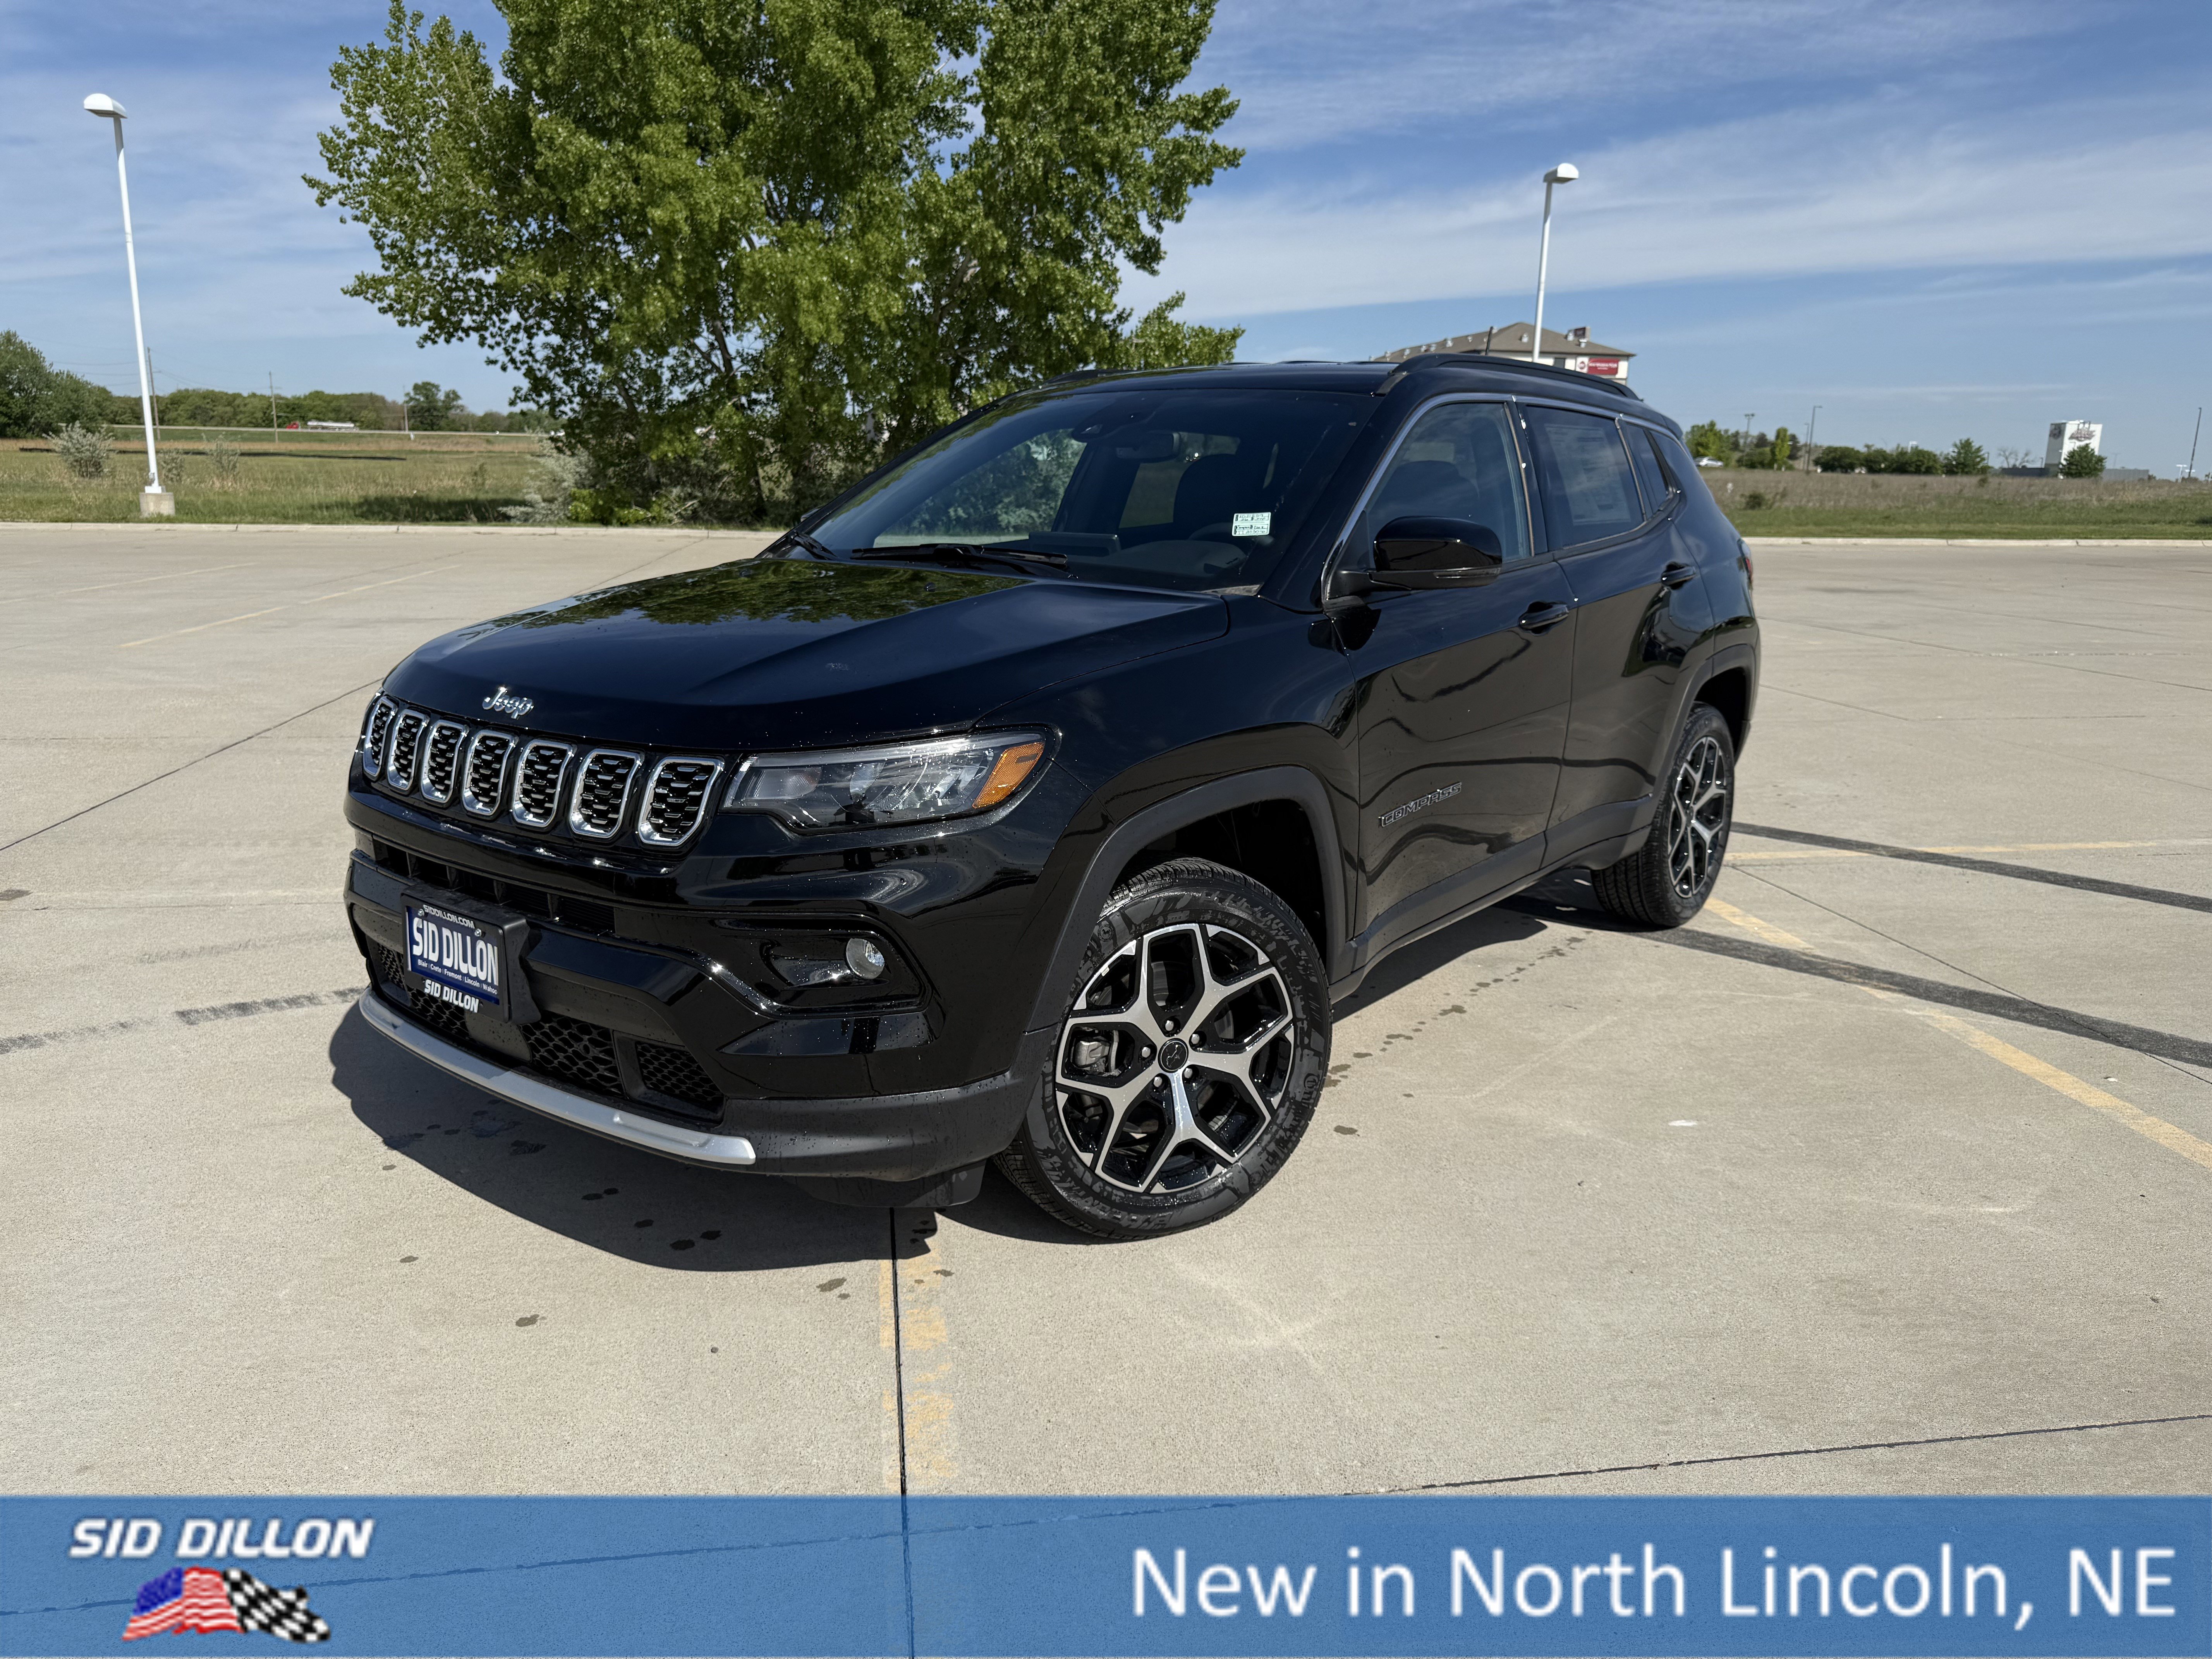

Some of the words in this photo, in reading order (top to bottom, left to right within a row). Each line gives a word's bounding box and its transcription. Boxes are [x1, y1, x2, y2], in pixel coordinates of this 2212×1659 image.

[482, 686, 534, 720] Jeep
[1379, 781, 1462, 827] COMPASS
[423, 904, 475, 929] SIDDILLON.COM
[413, 917, 439, 962] SID
[442, 927, 499, 986] DILLON
[418, 959, 428, 968] Blair
[430, 963, 442, 974] Crete
[444, 969, 462, 981] Fremont
[465, 977, 480, 988] Lincoln
[483, 984, 498, 995] Wahoo
[425, 979, 441, 998] SID
[443, 986, 479, 1013] DILLON
